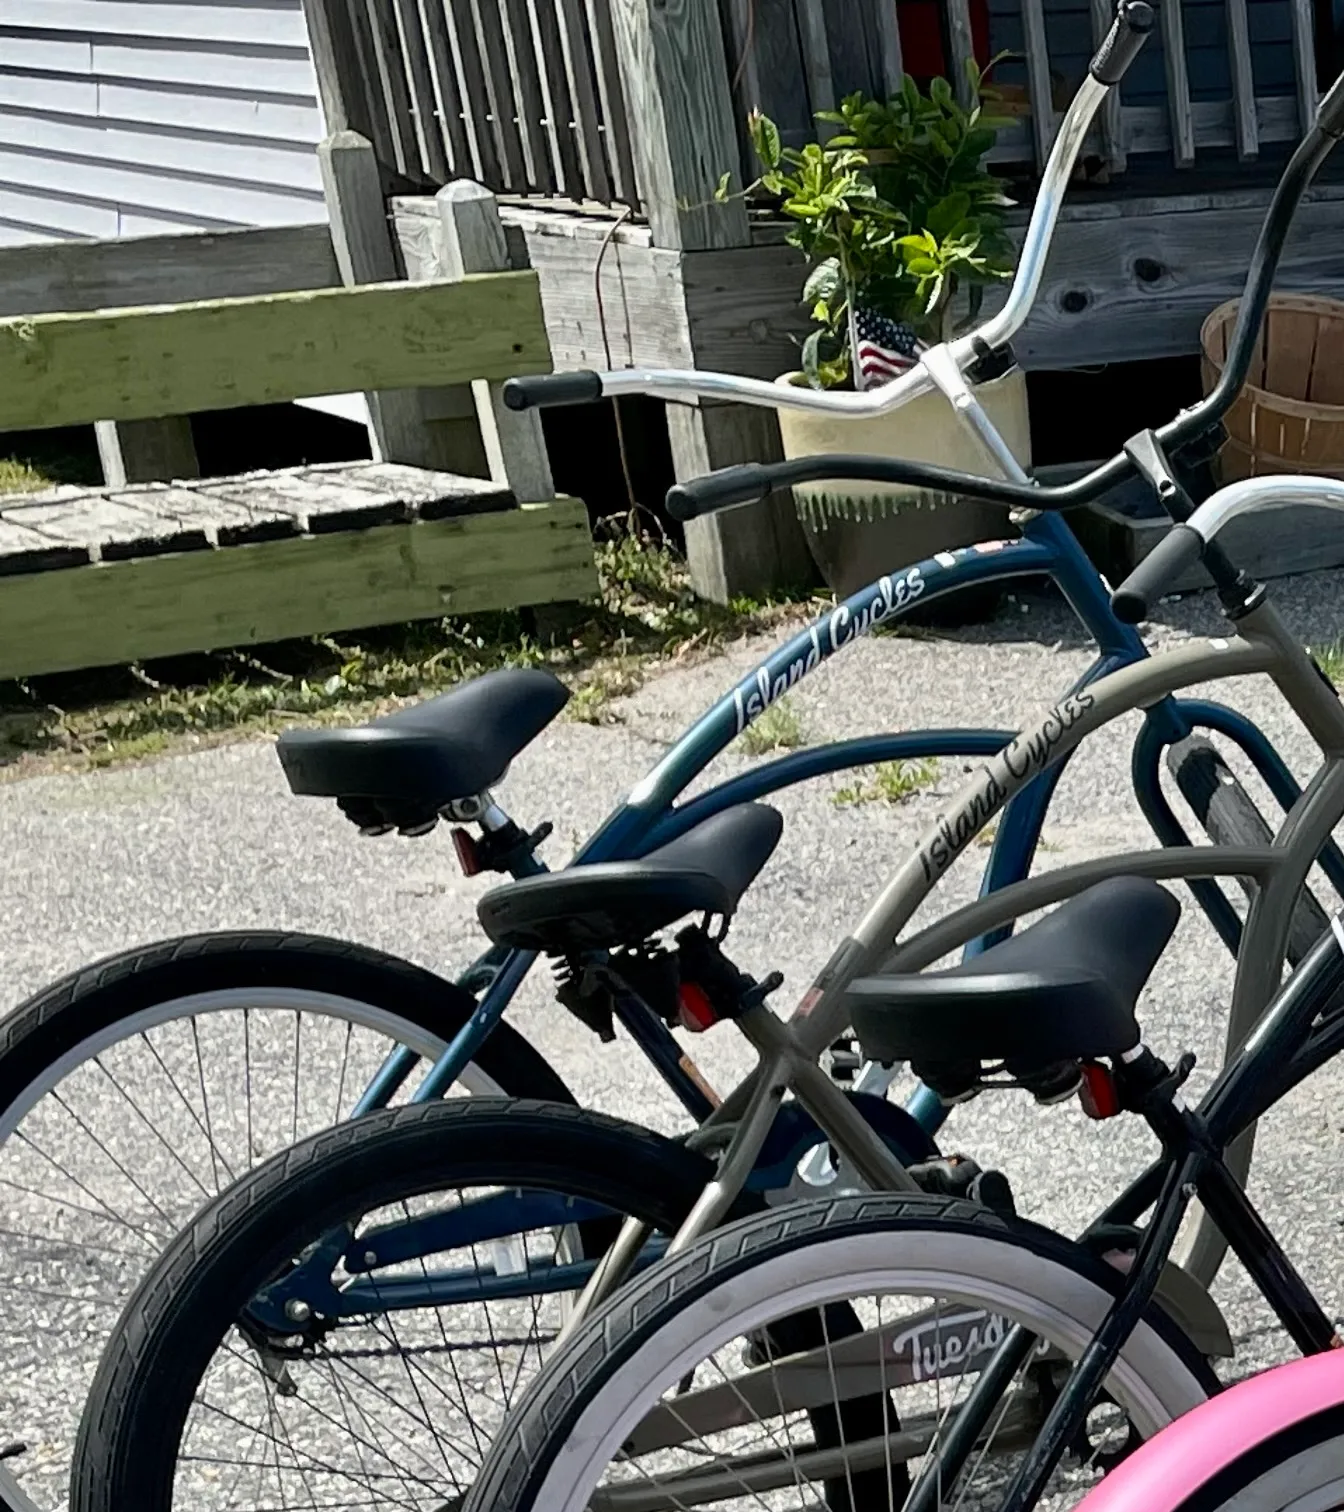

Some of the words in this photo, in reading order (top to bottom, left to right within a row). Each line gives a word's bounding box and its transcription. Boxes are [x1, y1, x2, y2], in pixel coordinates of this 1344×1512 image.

[734, 626, 821, 735] Island
[829, 567, 925, 651] Cycles
[919, 764, 1007, 883] Island
[1003, 692, 1095, 779] Cycles
[893, 1310, 1050, 1381] Tuesd
